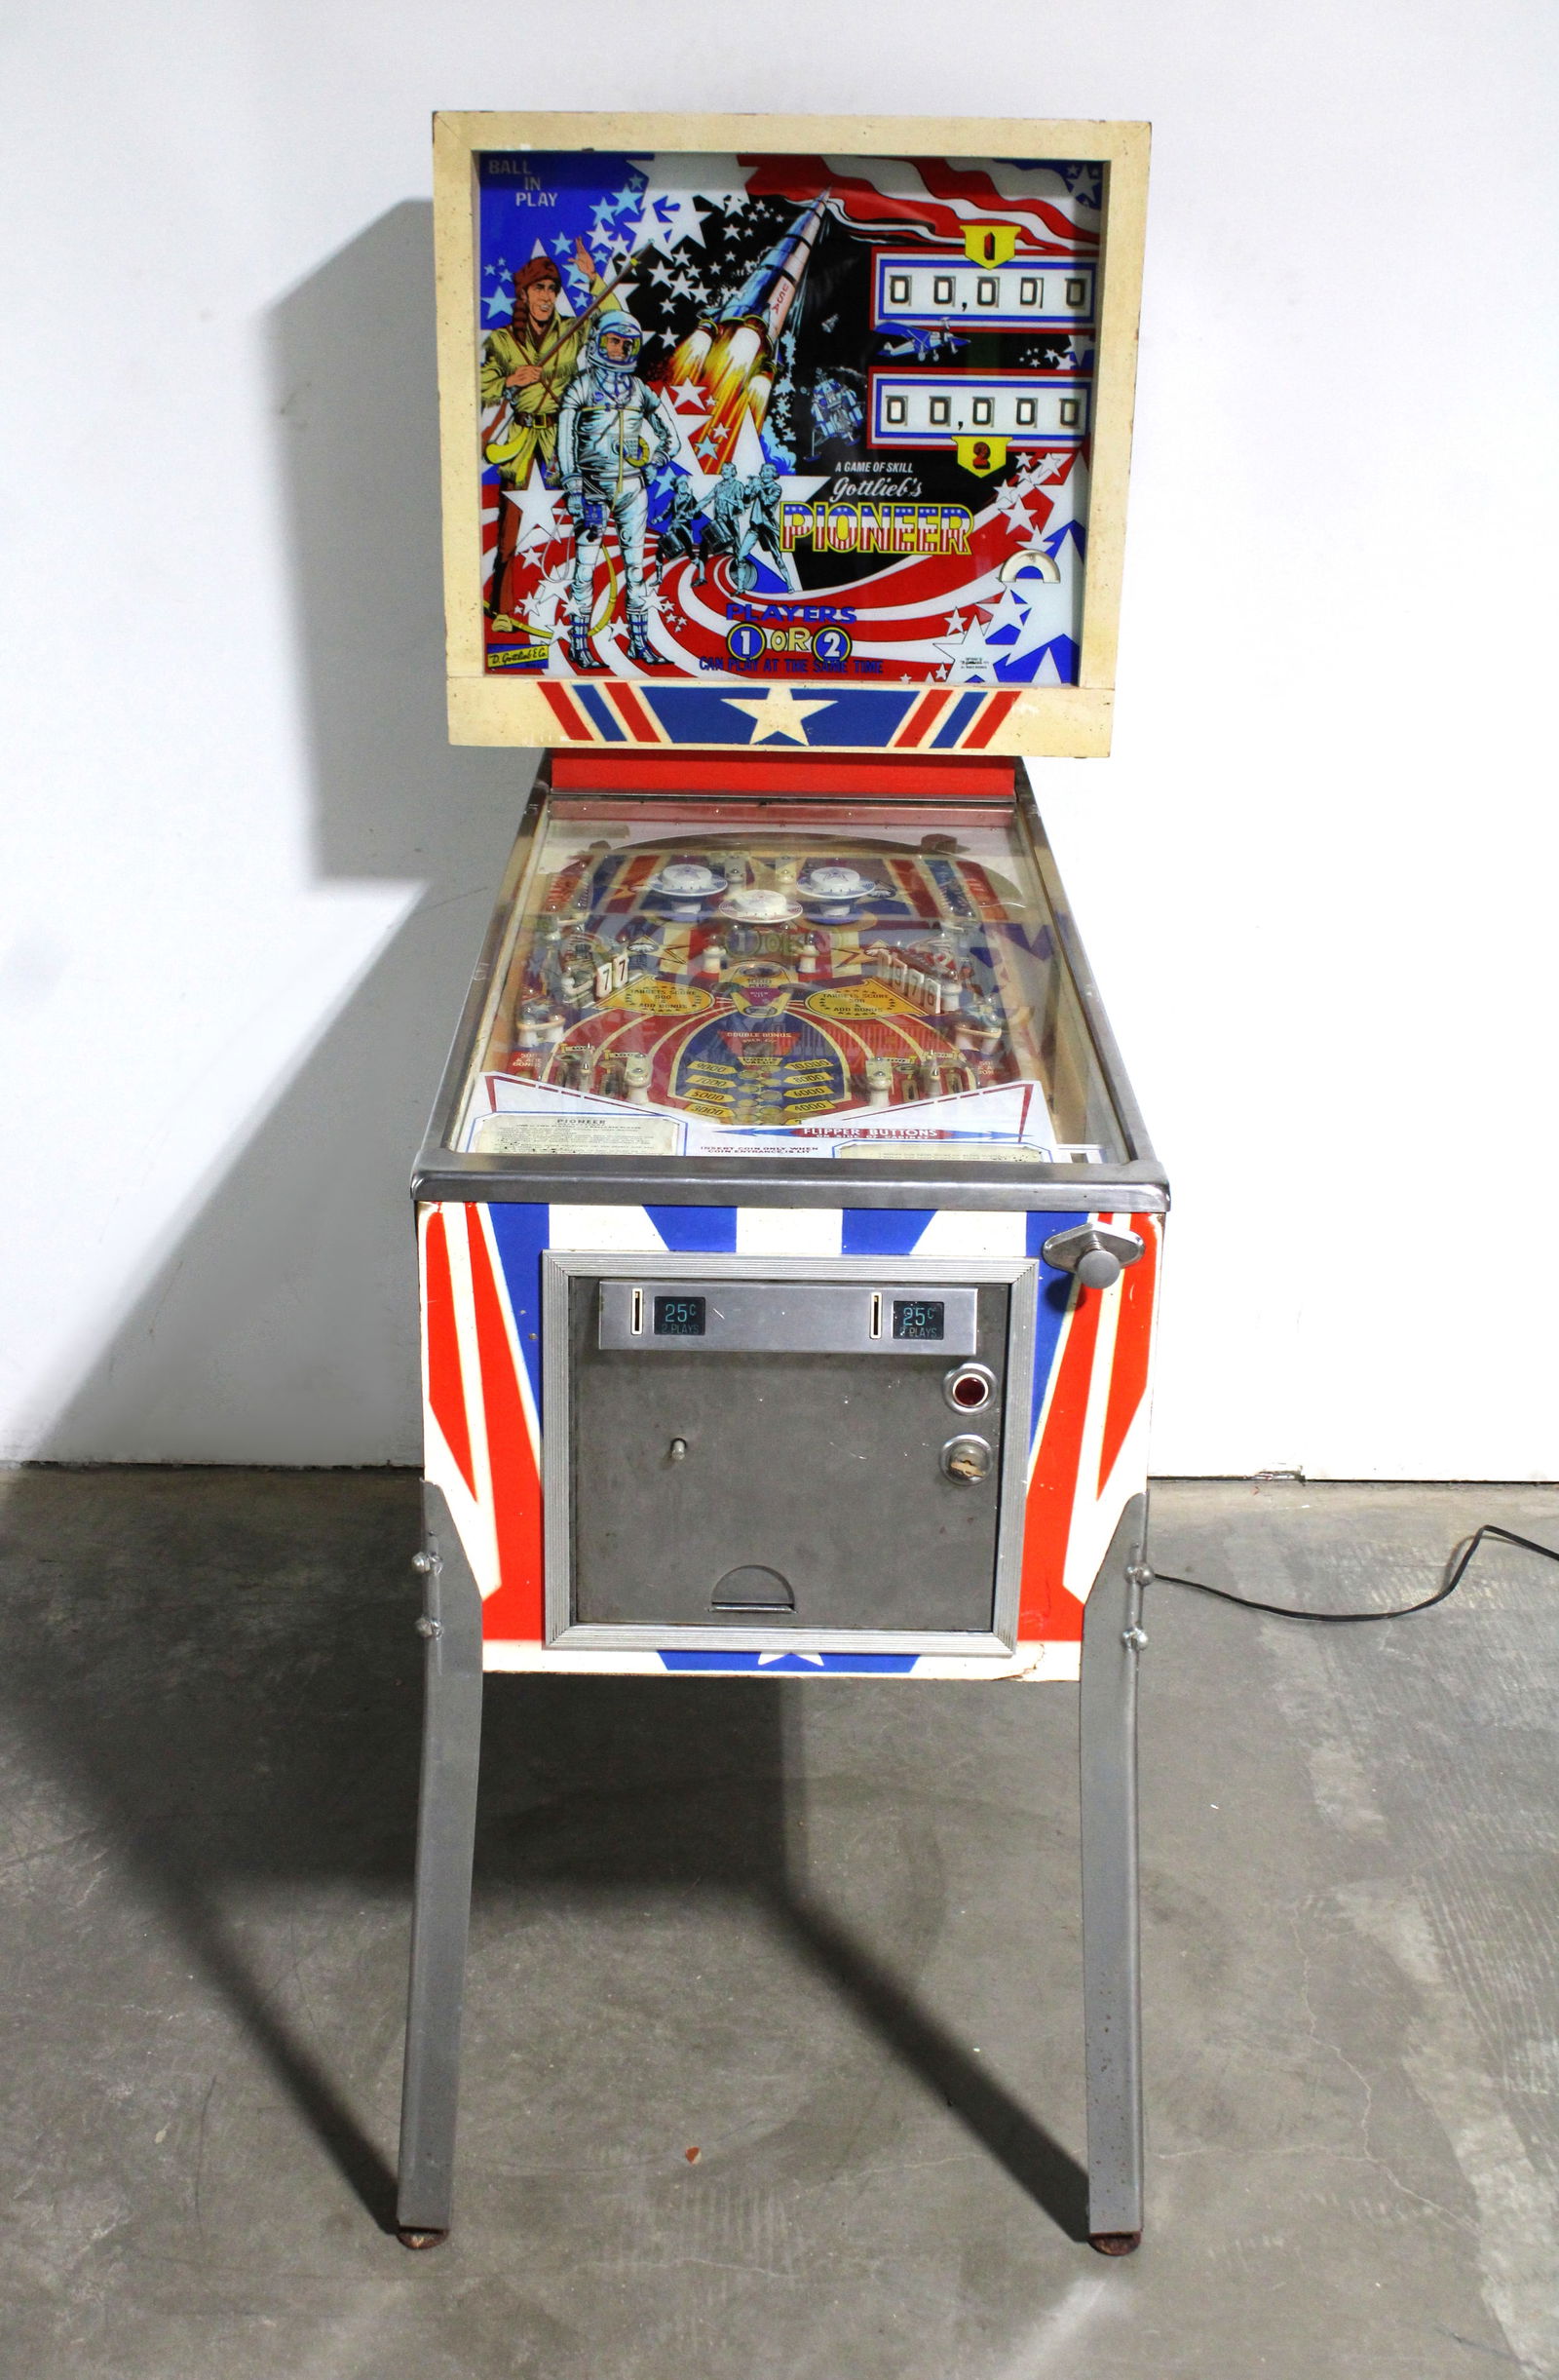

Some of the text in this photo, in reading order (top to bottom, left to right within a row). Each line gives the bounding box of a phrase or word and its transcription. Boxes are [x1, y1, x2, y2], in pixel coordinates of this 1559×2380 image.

[489, 160, 531, 174] BALL
[524, 176, 542, 191] IN
[515, 192, 558, 208] PLAY
[984, 232, 996, 260] 1
[972, 441, 991, 470] 2
[835, 462, 914, 475] A GAME OF SKILL
[829, 476, 924, 504] Gottlieb's
[780, 501, 974, 556] PIONEER
[726, 603, 857, 625] PLAYERS
[740, 630, 752, 656] 1
[823, 631, 842, 658] 2
[699, 656, 884, 673] CAN PLAY AT THE SAME TIME
[696, 1062, 727, 1073] 9000
[696, 1077, 727, 1088] 7000
[793, 1074, 825, 1084] 8000
[692, 1091, 725, 1101] 5000
[793, 1087, 825, 1097] 6000
[691, 1105, 724, 1116] 3000
[794, 1102, 826, 1111] 4000
[670, 1324, 700, 1334] PLAYS
[909, 1326, 937, 1338] PLAYS
